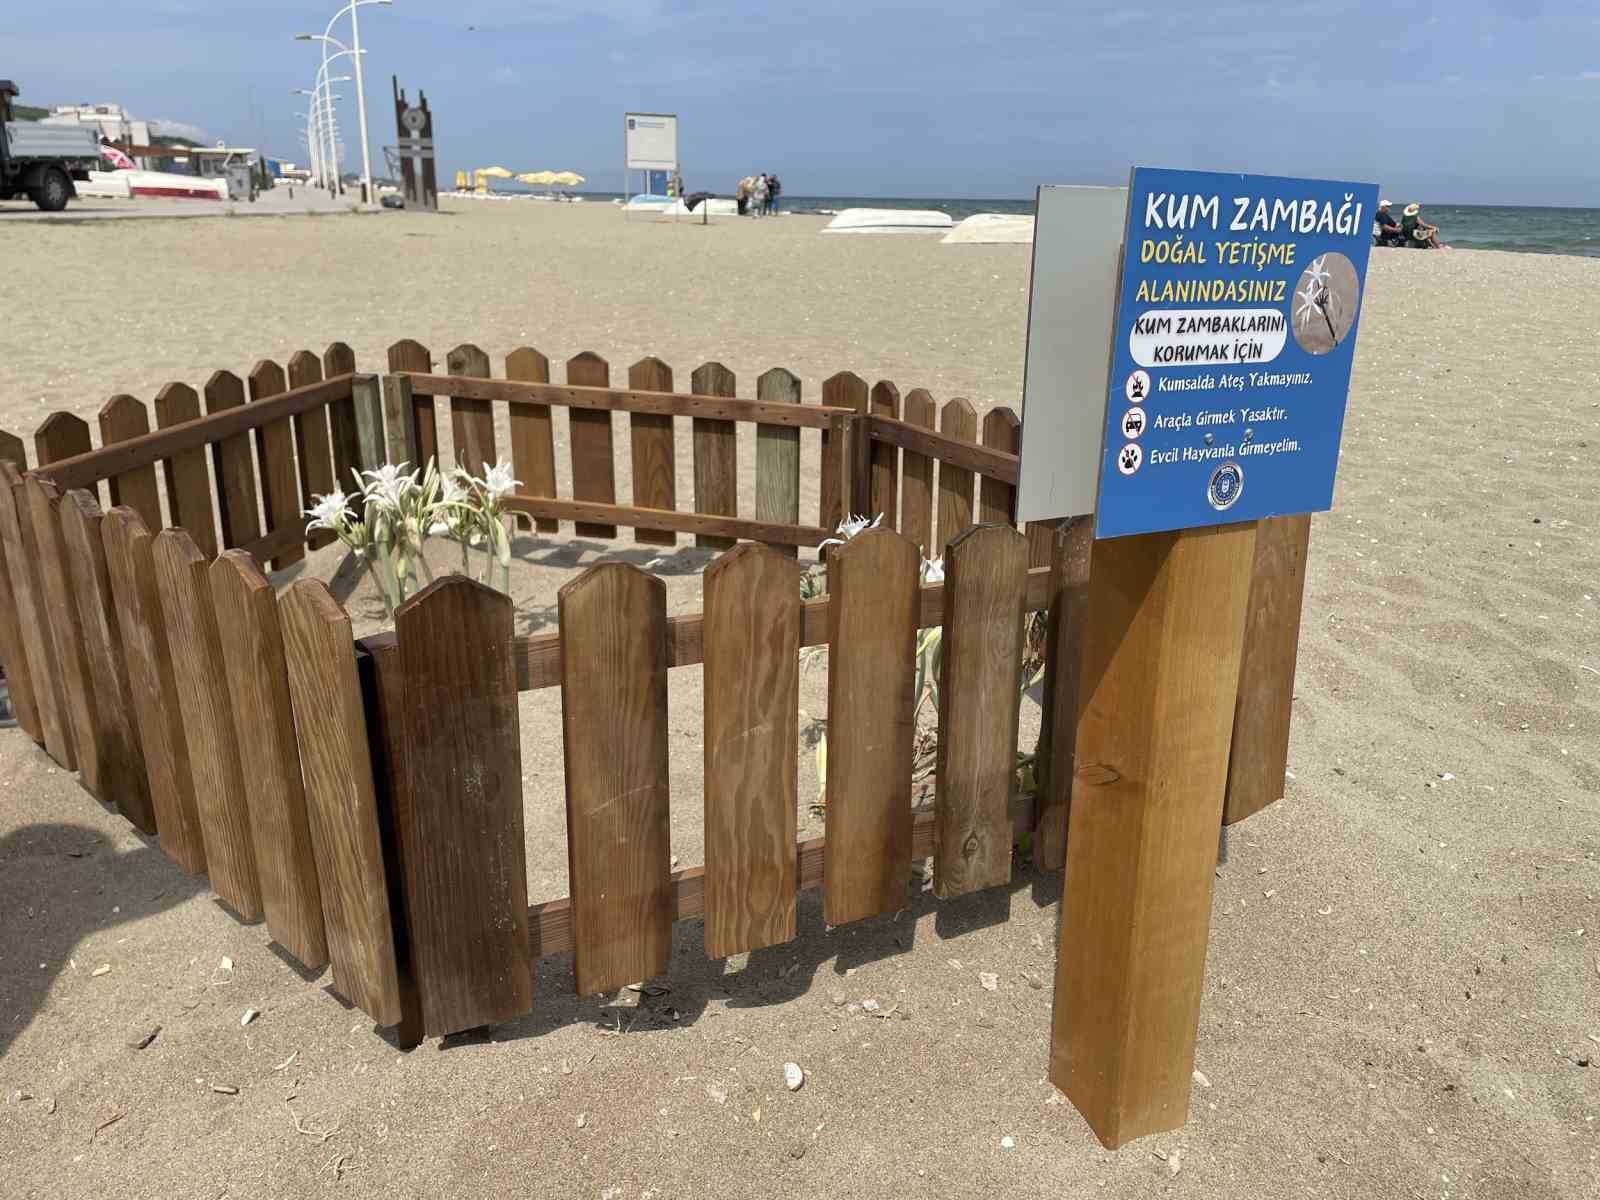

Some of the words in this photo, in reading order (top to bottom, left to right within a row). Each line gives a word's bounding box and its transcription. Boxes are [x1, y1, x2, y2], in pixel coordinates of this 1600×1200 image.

[1145, 192, 1219, 230] KUM
[1230, 193, 1363, 235] ZAMBAĞI
[1141, 234, 1206, 264] DOĞAL
[1216, 236, 1296, 271] YETİŞME
[1136, 279, 1287, 303] ALANINDASINIZ
[1135, 317, 1172, 335] KUM
[1176, 315, 1285, 334] ZAMBAKLARINI
[1153, 344, 1230, 362] KORUMAK
[1233, 338, 1263, 363] İÇİN
[1158, 374, 1215, 392] Kumsalda
[1218, 374, 1245, 391] Ateş
[1249, 372, 1313, 387] Yakmayınız.
[1154, 412, 1191, 430] Araçla
[1196, 408, 1235, 425] Girmek
[1240, 406, 1288, 423] Yasaktır.
[1150, 447, 1180, 464] Evcil
[1182, 443, 1235, 462] Hayvanla
[1238, 438, 1301, 456] Girmeyelim.
